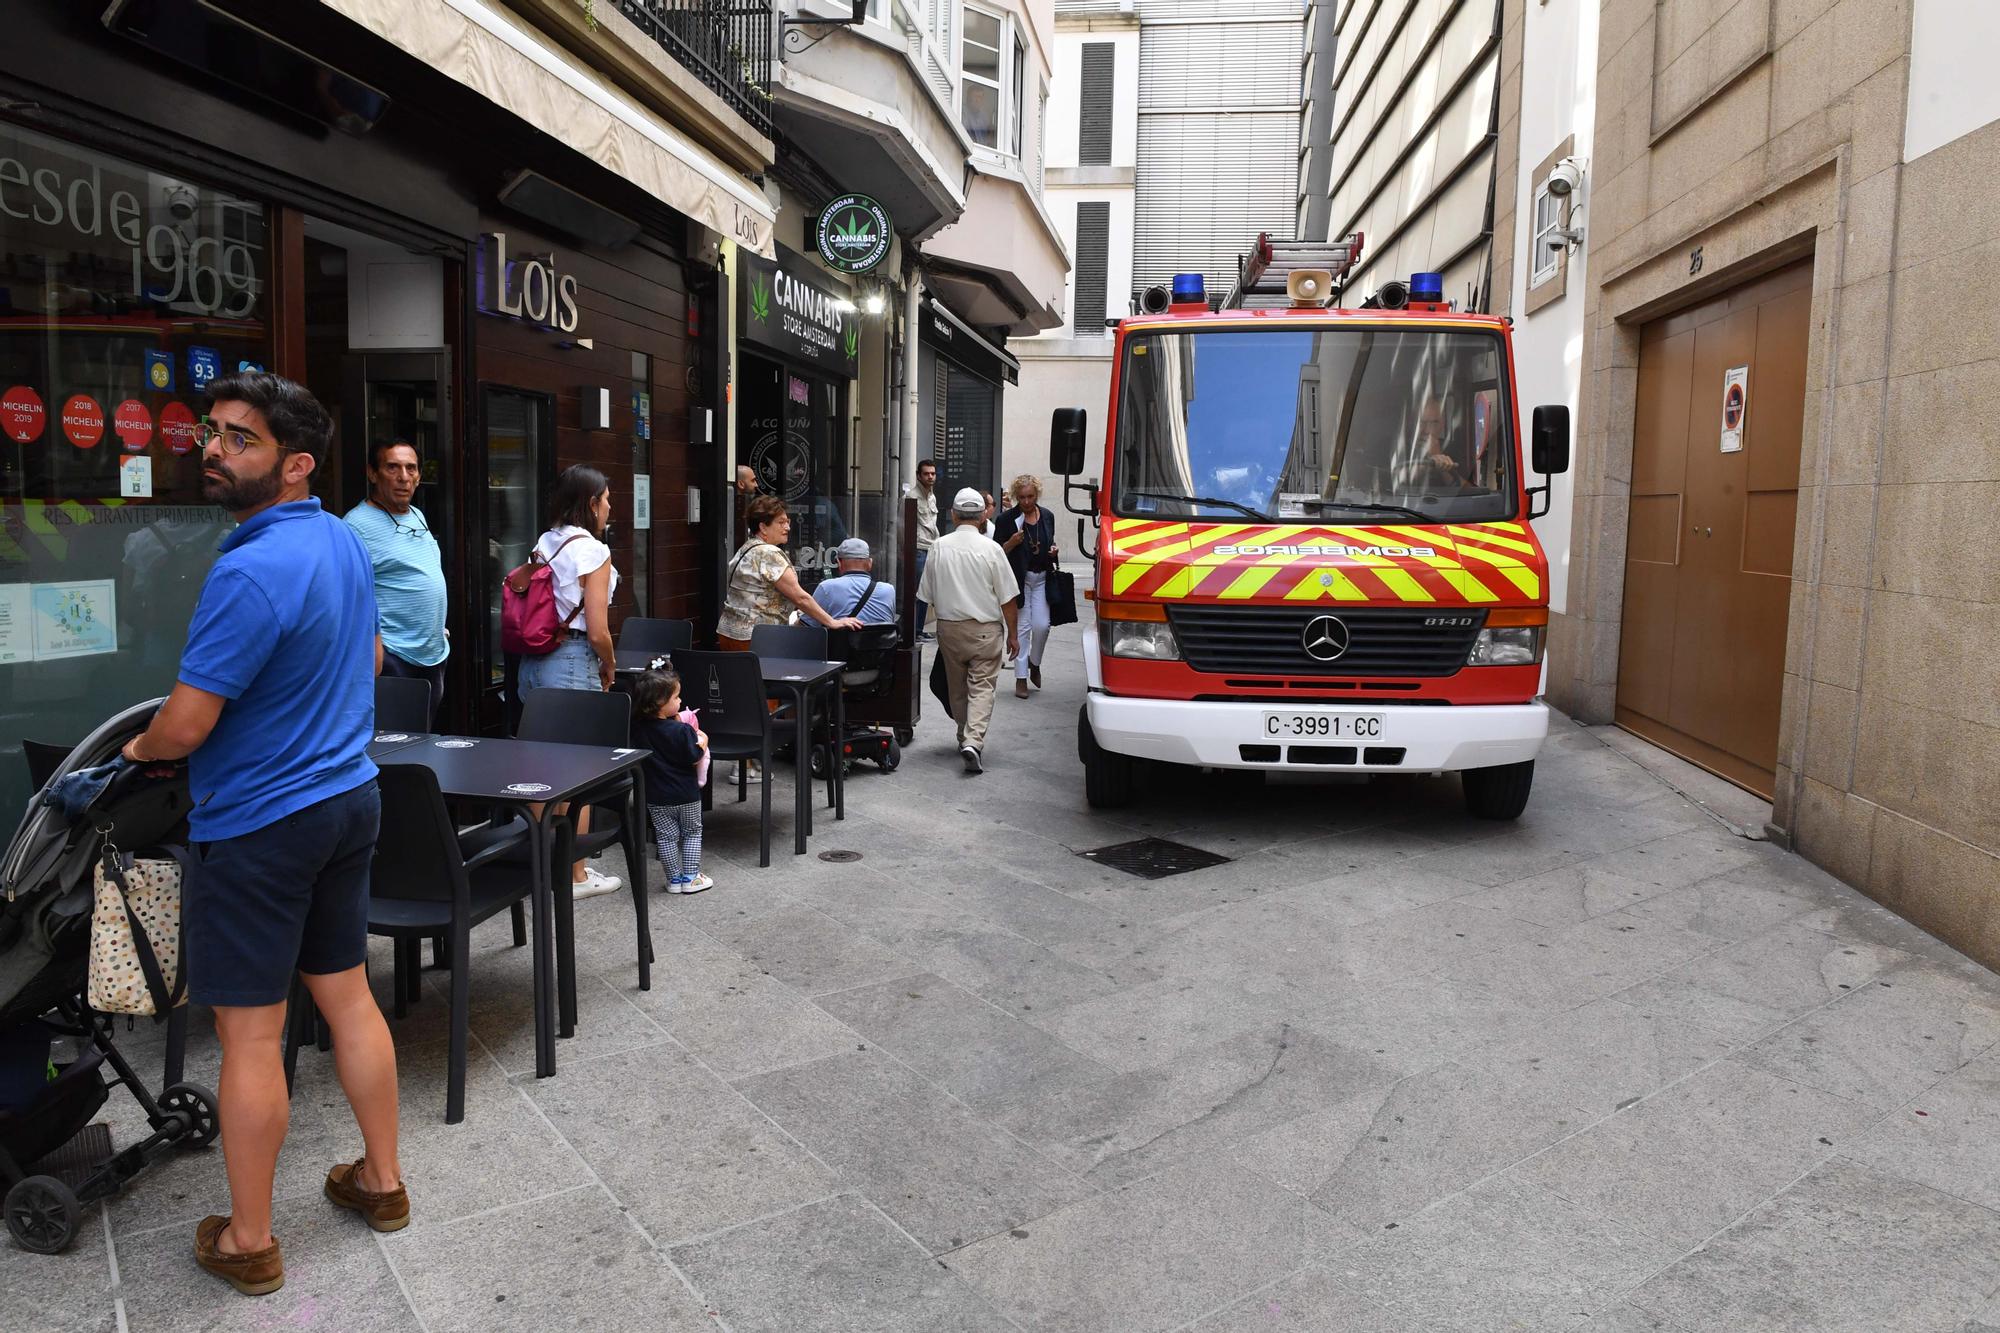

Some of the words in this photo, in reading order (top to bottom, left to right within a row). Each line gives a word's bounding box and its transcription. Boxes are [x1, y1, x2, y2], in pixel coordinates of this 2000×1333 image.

[821, 198, 854, 229] AMSTERDAM
[872, 206, 887, 237] ORIGINAL
[819, 229, 835, 260] ORIGINAL
[830, 234, 876, 243] CANNABIS
[852, 239, 886, 269] AMSTERDAM
[120, 219, 257, 317] 1969
[774, 269, 842, 334] CANNABIS
[783, 314, 802, 337] STORE
[803, 324, 836, 351] AMSTERDAM
[195, 363, 214, 380] 9,3
[3, 402, 42, 413] MICHELIN
[75, 401, 91, 410] 2018
[126, 404, 141, 412] 2017
[14, 413, 32, 423] 2019
[63, 416, 103, 428] MICHELIN
[115, 420, 152, 431] MICHELIN
[163, 428, 194, 437] MICHELIN
[156, 507, 213, 524] PRIMERA
